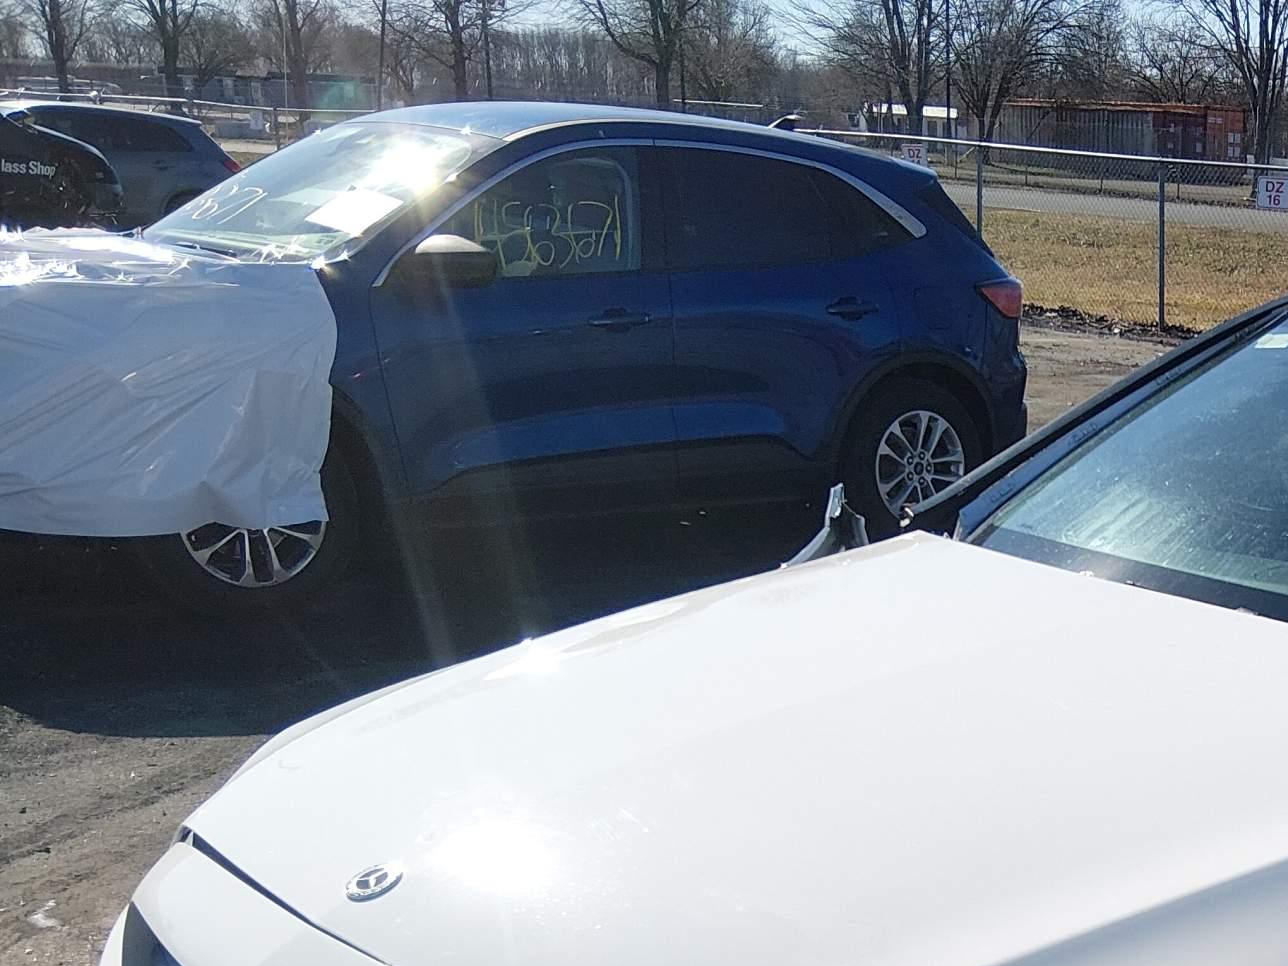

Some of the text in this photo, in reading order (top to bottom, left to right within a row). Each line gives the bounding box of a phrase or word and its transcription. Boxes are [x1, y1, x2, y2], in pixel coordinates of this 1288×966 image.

[28, 161, 56, 179] Shop
[1265, 181, 1285, 193] DZ
[1267, 194, 1281, 206] 16
